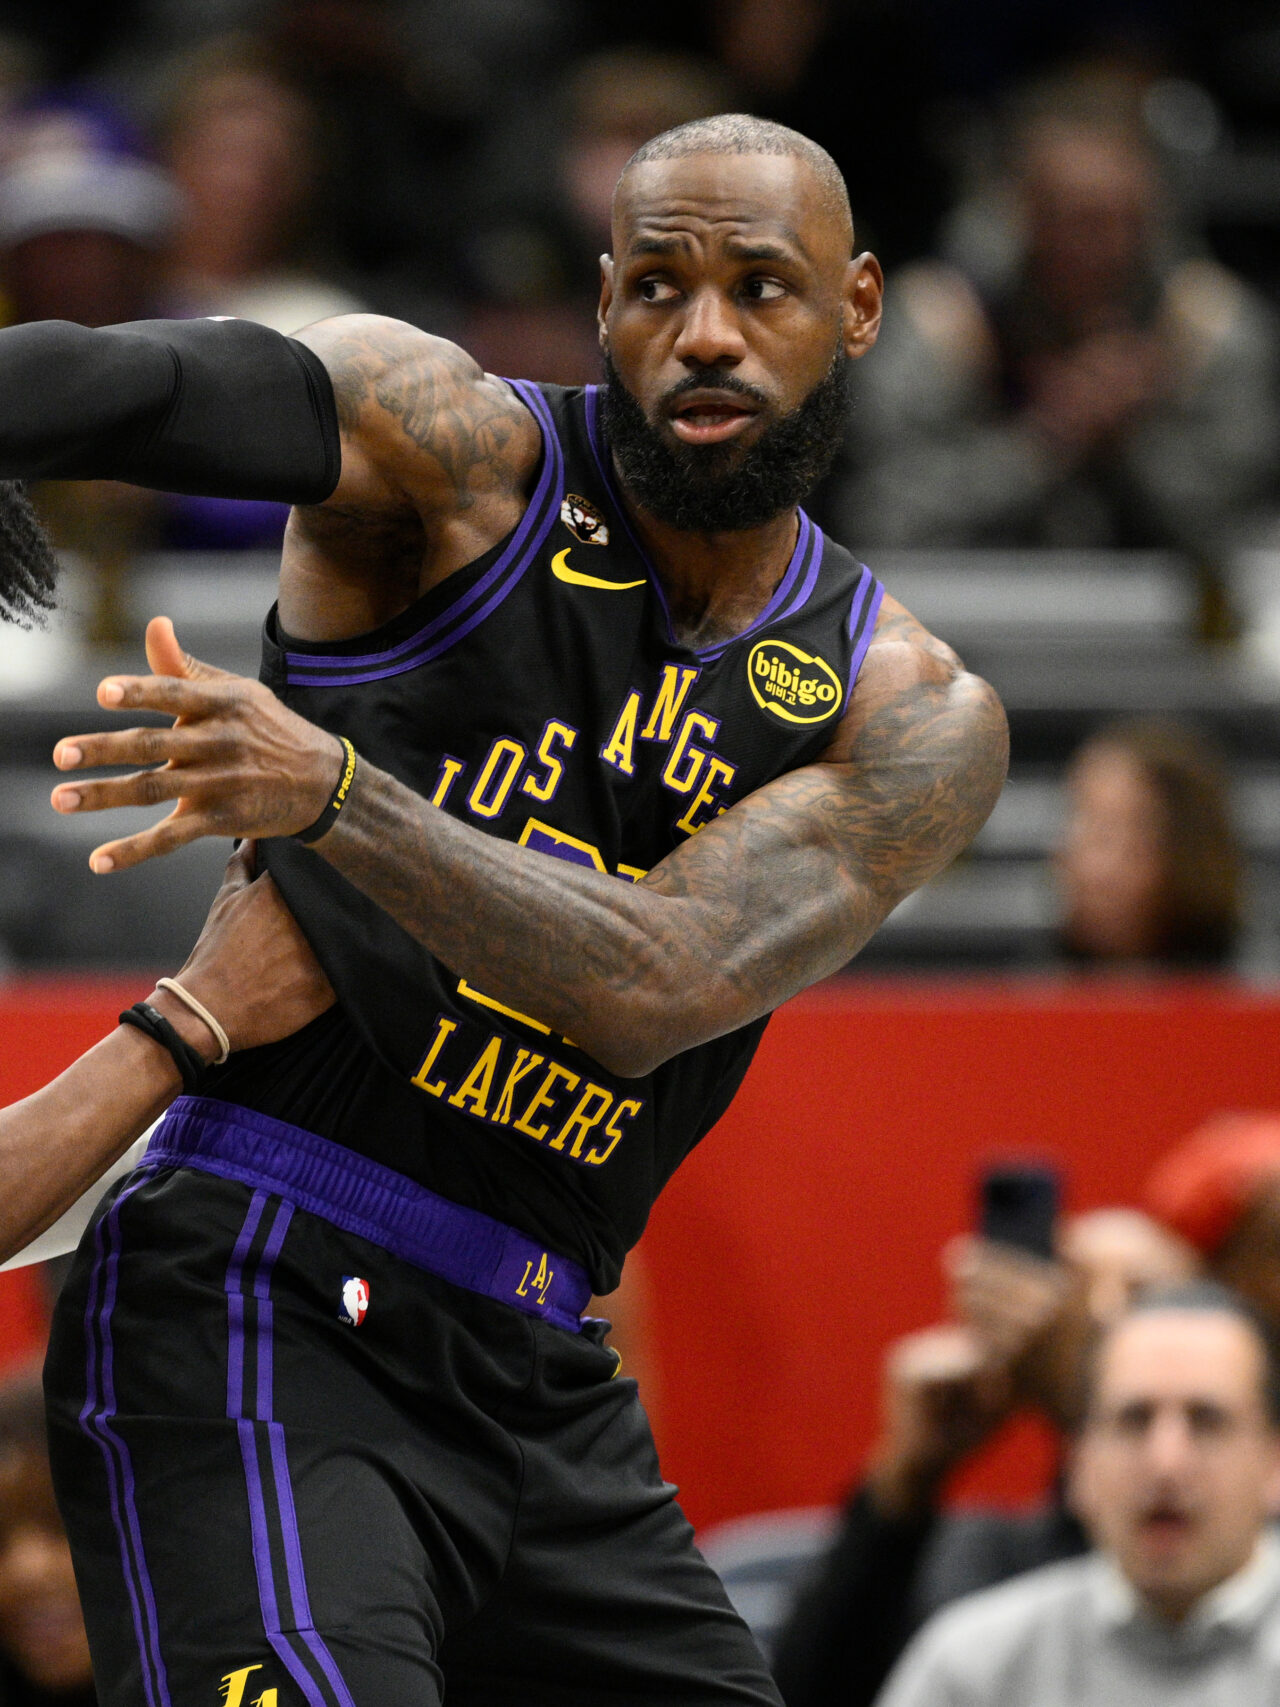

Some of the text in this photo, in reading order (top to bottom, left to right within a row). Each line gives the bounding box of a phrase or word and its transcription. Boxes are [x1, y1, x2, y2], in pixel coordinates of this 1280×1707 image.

[755, 651, 836, 705] bibigo
[764, 680, 797, 706] 비비고
[601, 663, 737, 836] ANGE
[409, 1015, 644, 1166] LAKERS
[515, 1252, 554, 1305] LAL
